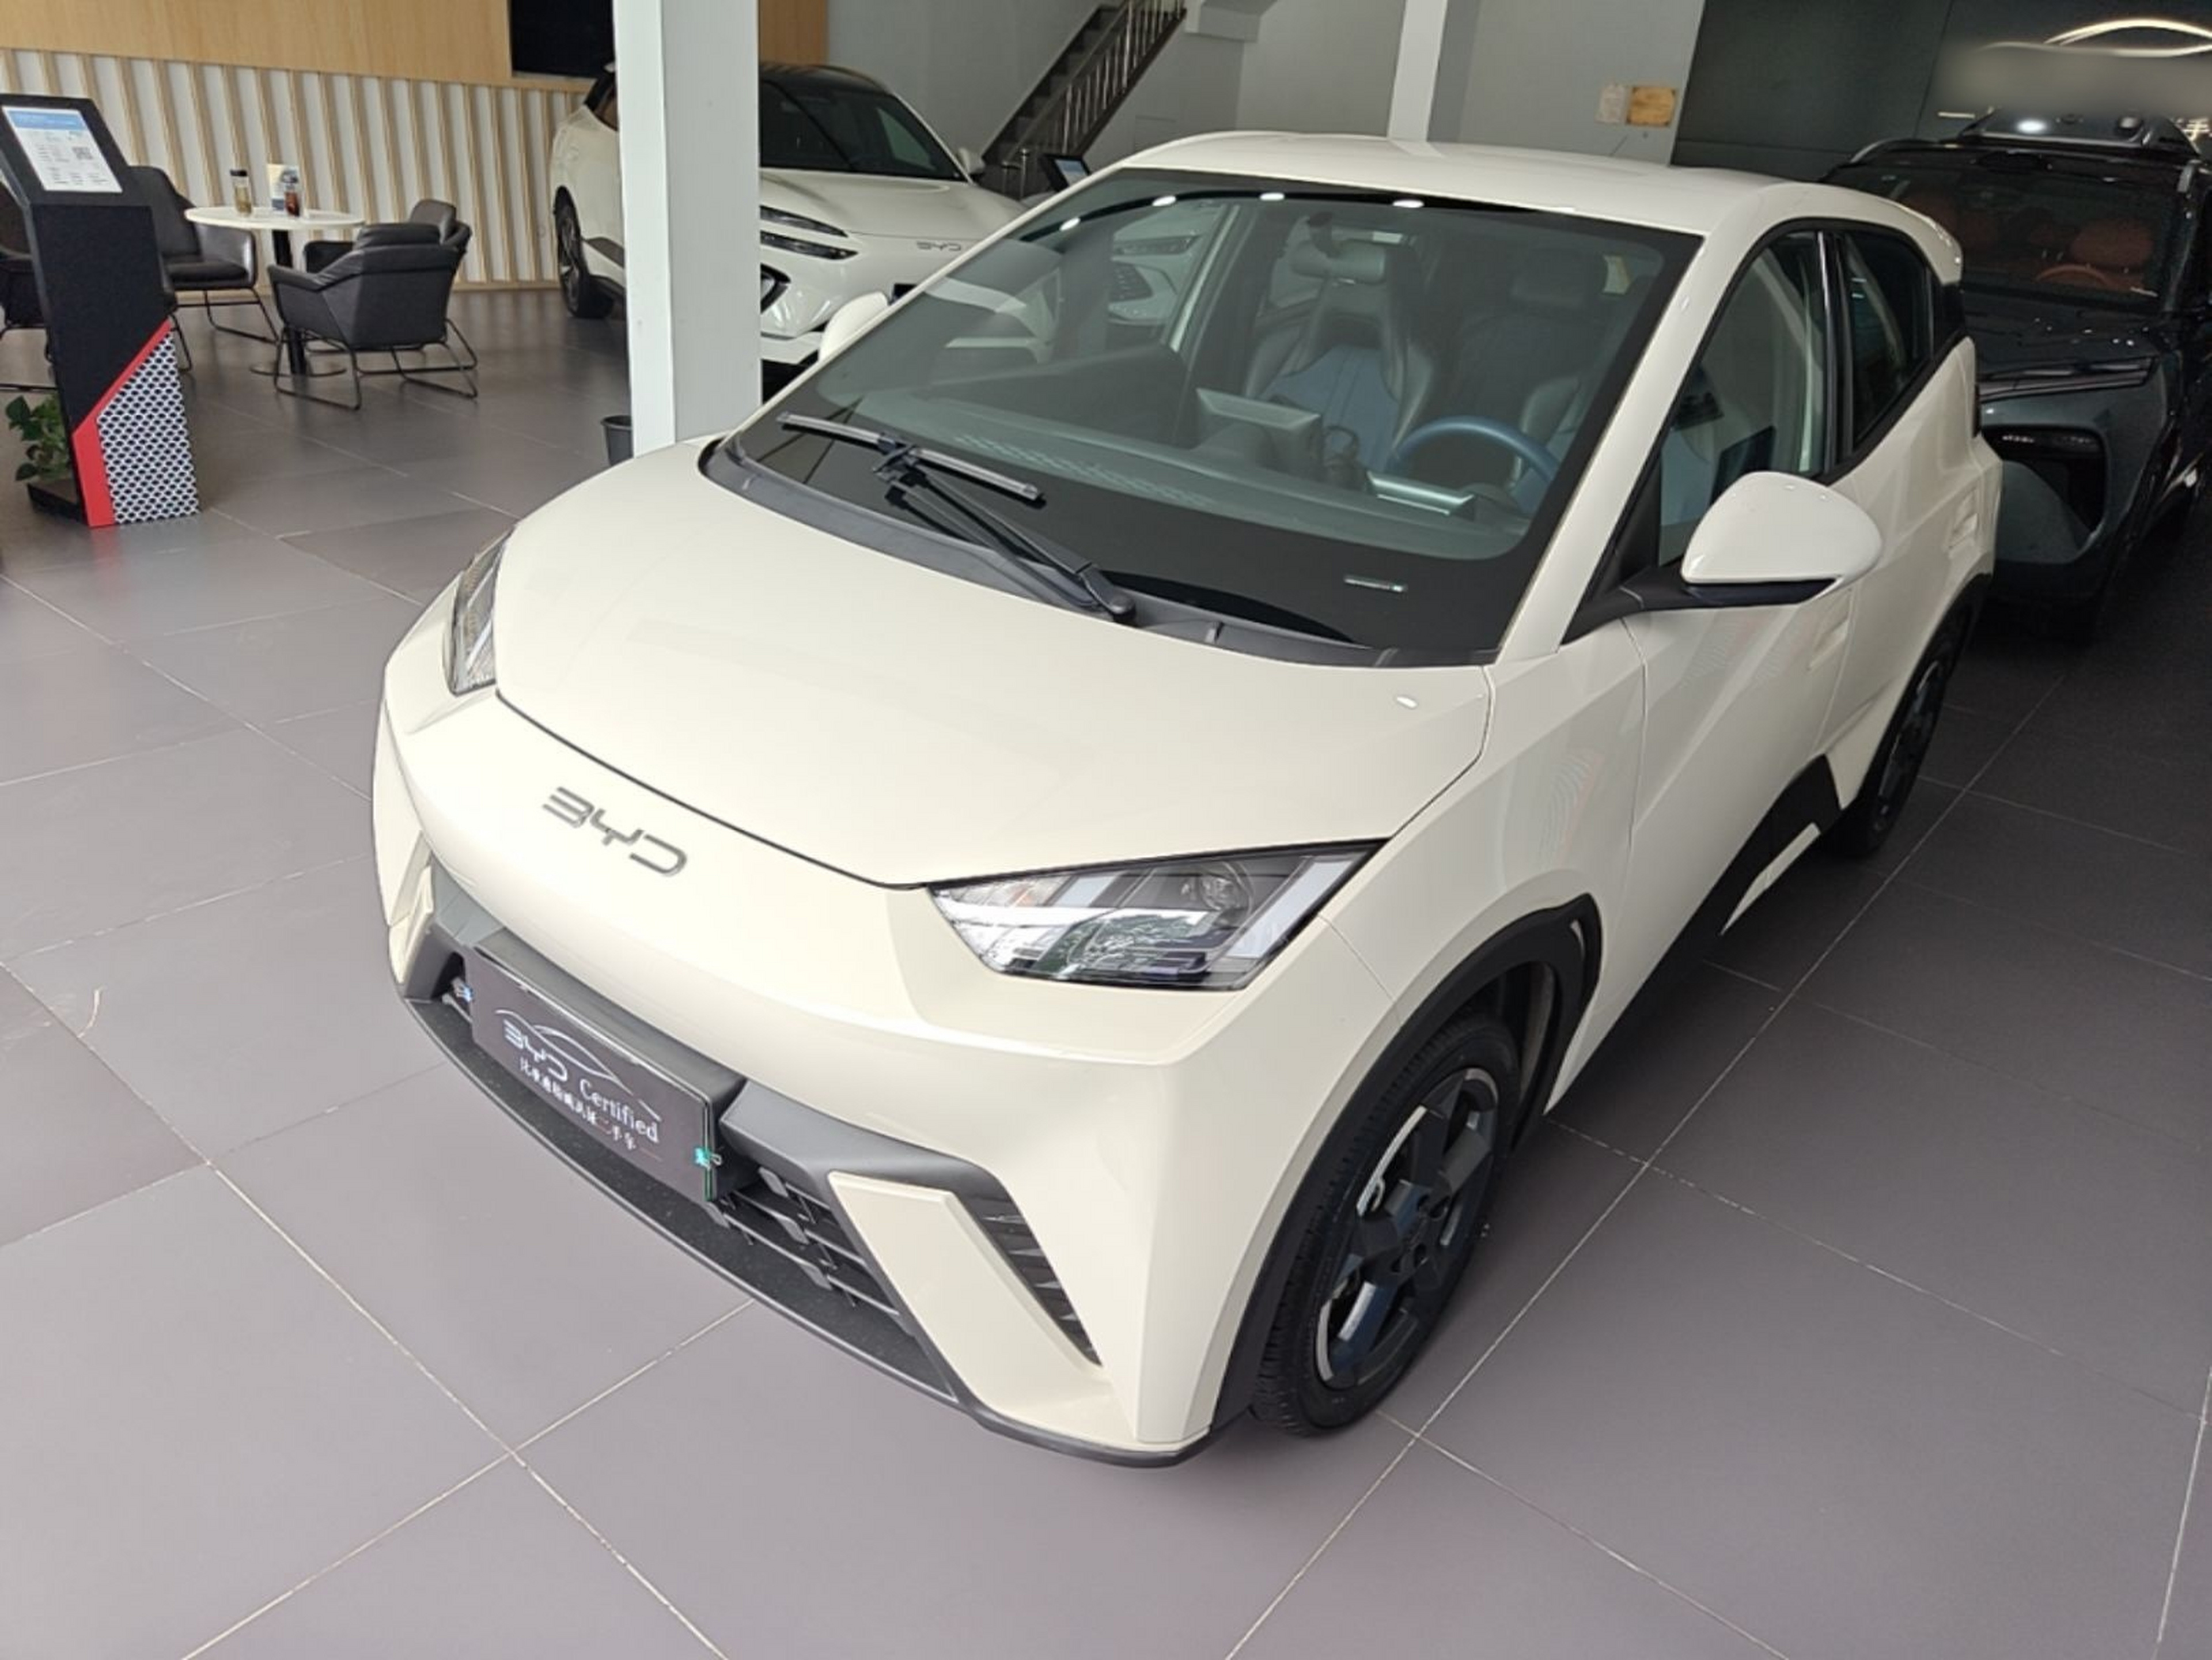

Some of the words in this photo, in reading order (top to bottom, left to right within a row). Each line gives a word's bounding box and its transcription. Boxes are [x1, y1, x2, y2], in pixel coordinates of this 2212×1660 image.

[916, 241, 961, 251] BYD
[543, 786, 687, 876] BYD
[503, 1020, 567, 1082] BYD
[579, 1079, 658, 1143] Certified
